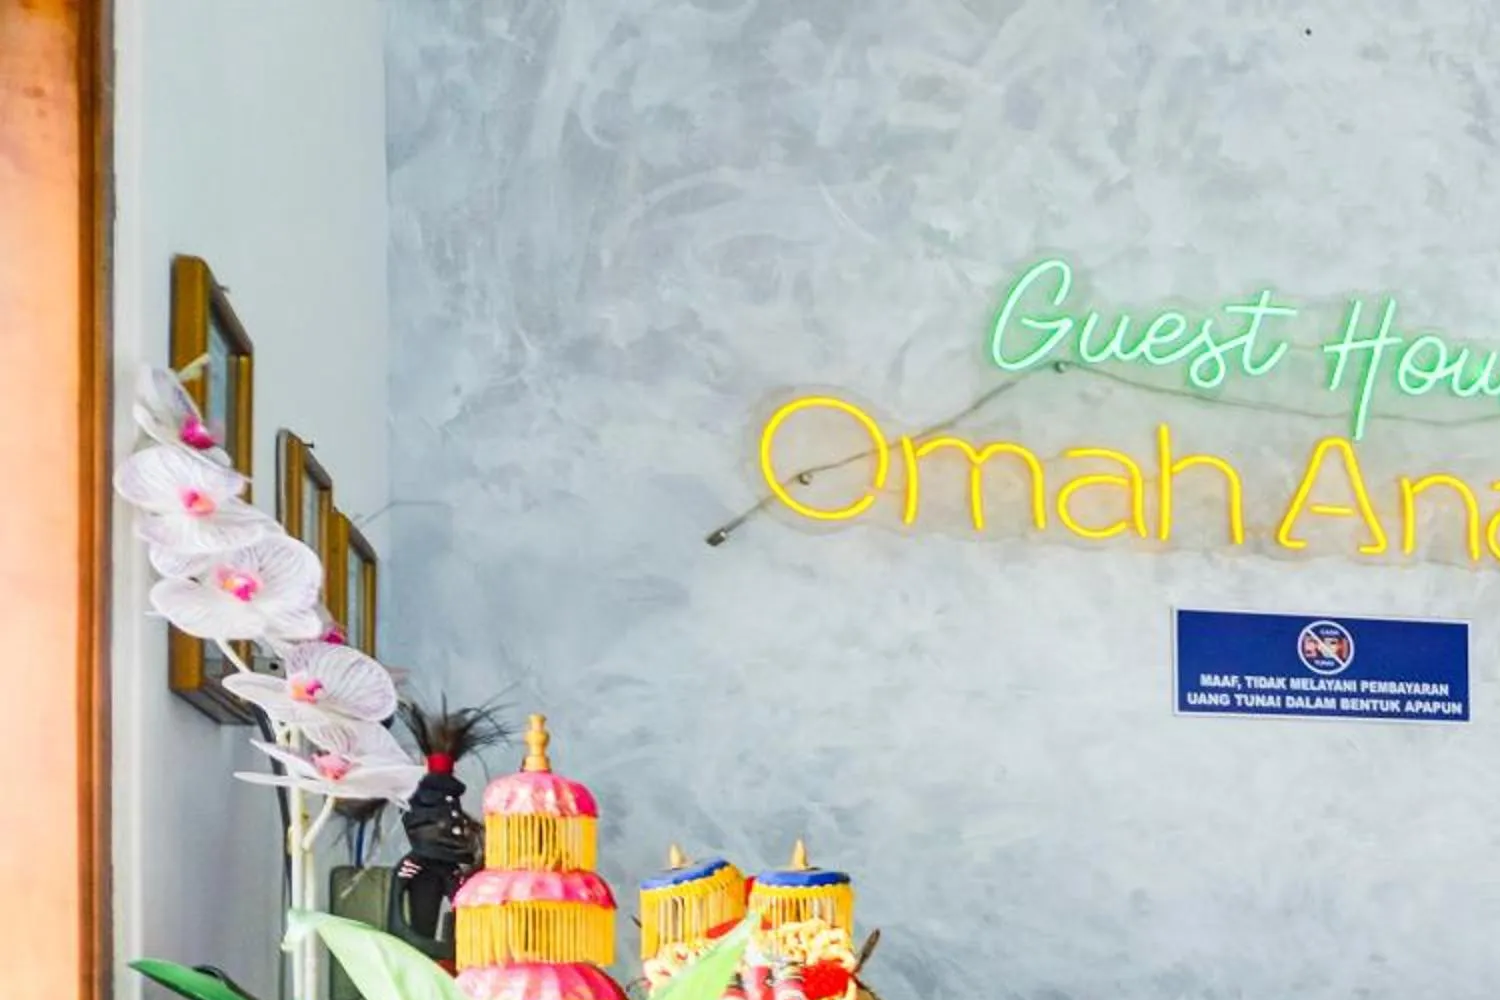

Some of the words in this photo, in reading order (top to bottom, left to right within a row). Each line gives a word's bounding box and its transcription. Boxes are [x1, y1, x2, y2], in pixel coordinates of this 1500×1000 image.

[991, 258, 1298, 389] Guest
[759, 396, 1245, 547] Omah
[1187, 692, 1230, 706] UANG
[1234, 693, 1281, 708] TUNAI
[1285, 695, 1337, 711] DALAM
[1340, 697, 1401, 714] BENTUK
[1404, 700, 1463, 717] APAPUN
[1200, 674, 1241, 691] MAAF,
[1245, 675, 1286, 690] TIDAK
[1290, 678, 1357, 694] MELAYANI
[1360, 680, 1449, 698] PEMBAYARAN
